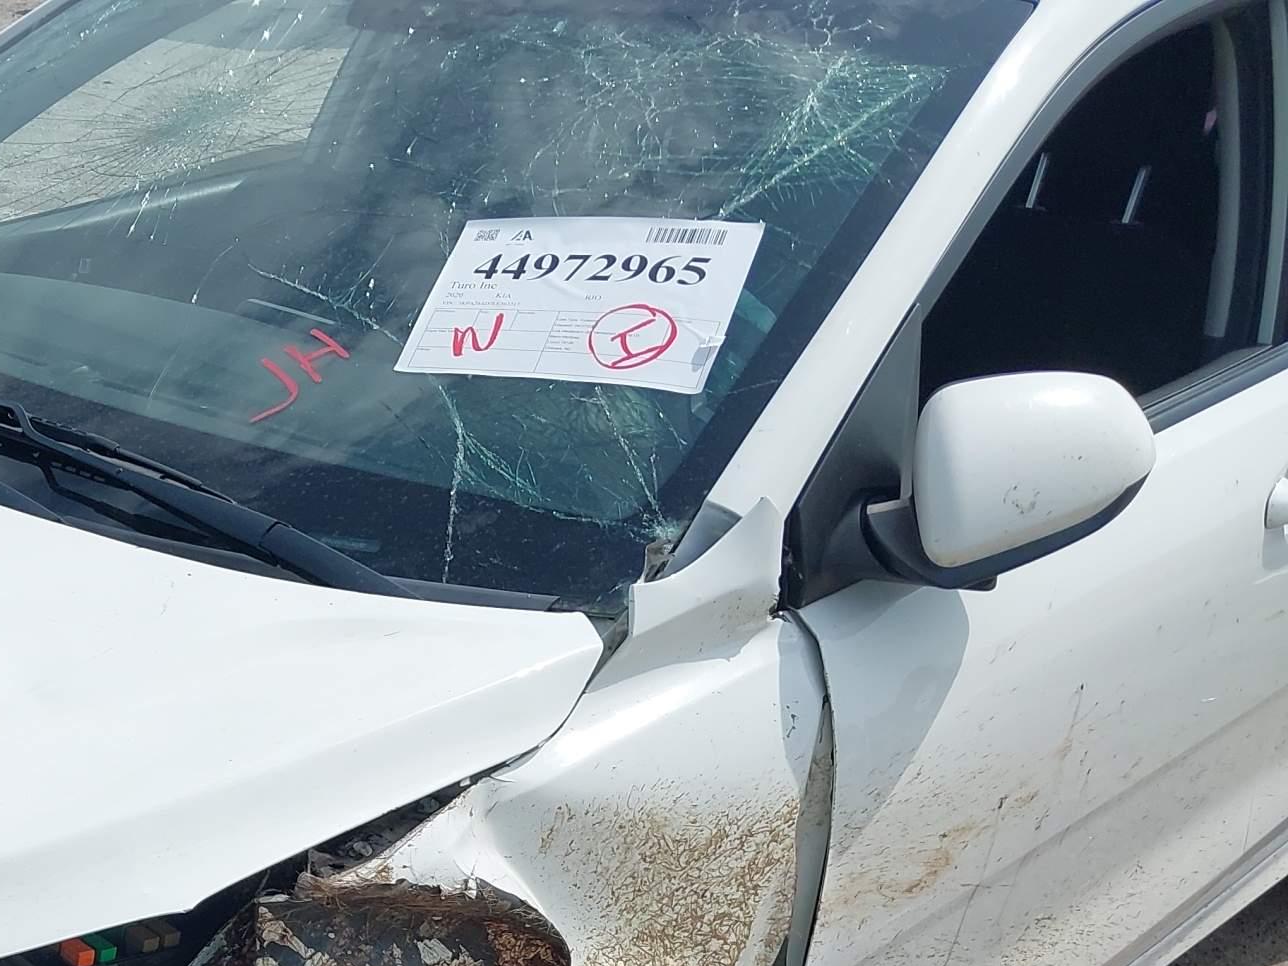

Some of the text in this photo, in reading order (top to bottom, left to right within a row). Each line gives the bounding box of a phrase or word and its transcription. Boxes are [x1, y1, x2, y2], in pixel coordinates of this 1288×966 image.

[473, 253, 712, 286] 44972965
[450, 281, 498, 290] Turo Inc
